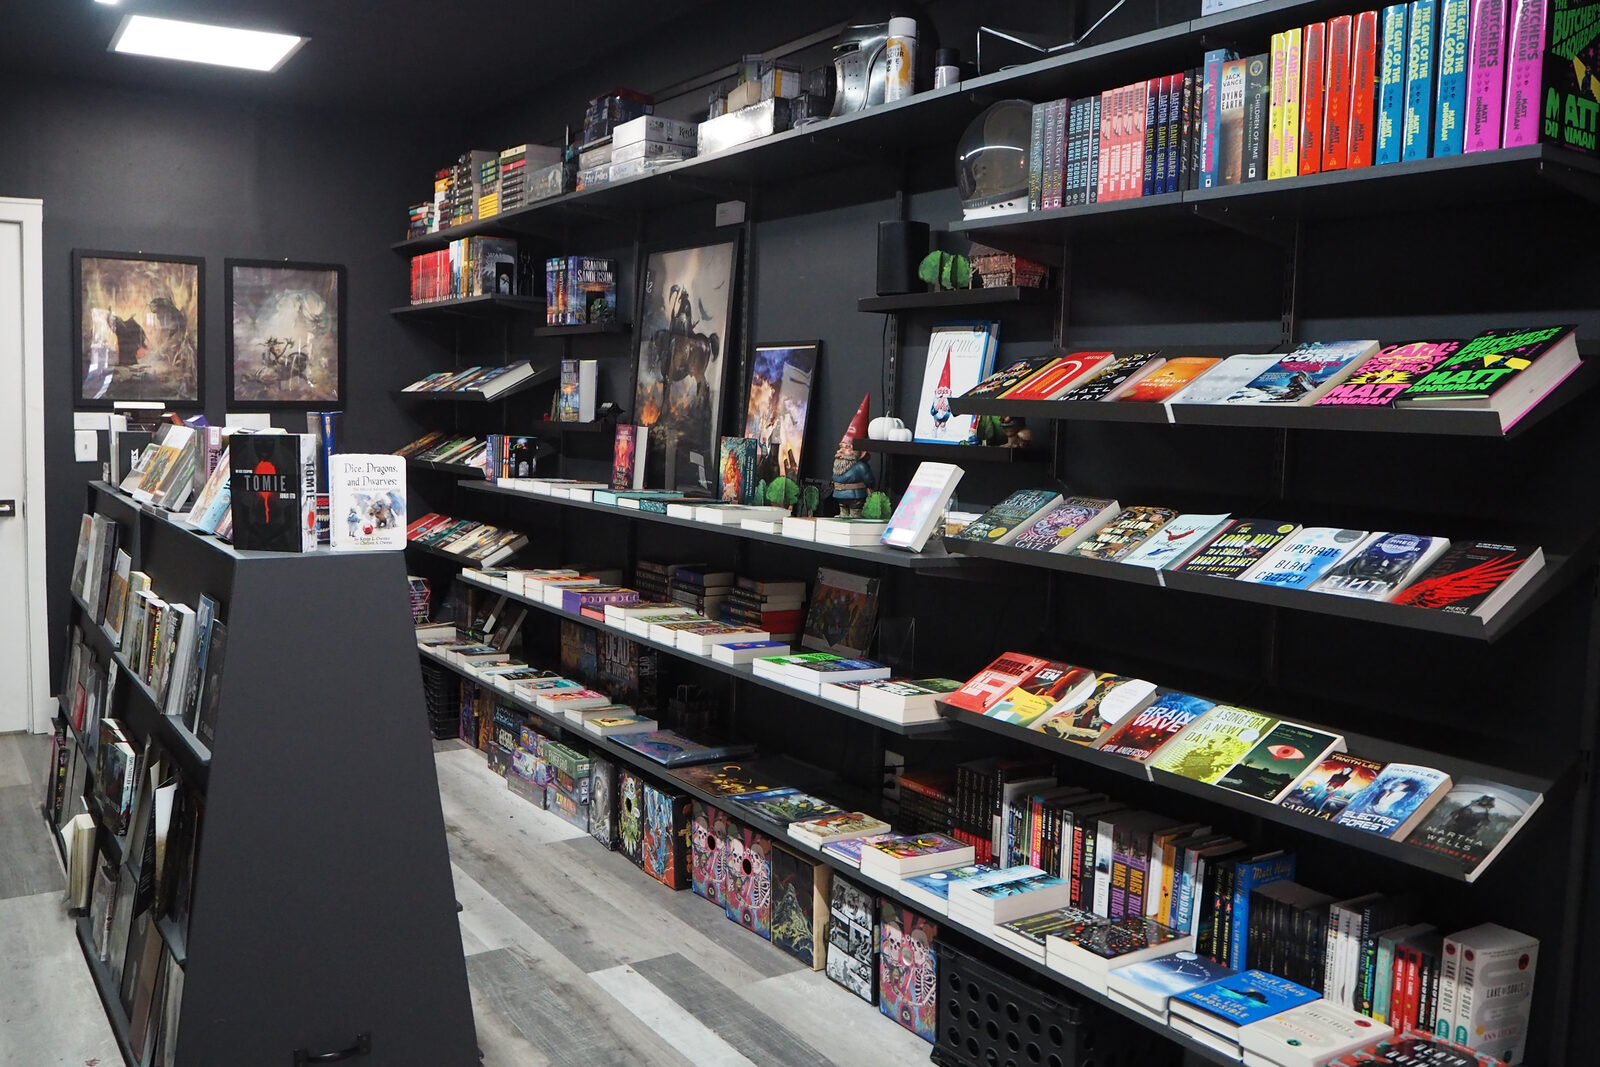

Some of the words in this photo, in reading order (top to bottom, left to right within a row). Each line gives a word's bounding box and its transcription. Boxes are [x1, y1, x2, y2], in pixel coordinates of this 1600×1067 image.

[1423, 6, 1431, 22] THE
[1458, 0, 1466, 13] THE
[1395, 12, 1403, 29] THE
[1457, 13, 1465, 40] GATE
[1395, 29, 1403, 53] GATE
[1422, 22, 1430, 48] GATE
[1420, 49, 1429, 61] OF
[1444, 38, 1455, 75] GODS
[1456, 42, 1464, 54] OF
[1383, 51, 1392, 85] GODS
[1393, 54, 1401, 66] OF
[1409, 44, 1420, 81] GODS
[1455, 55, 1463, 72] THE
[1392, 66, 1400, 83] THE
[1418, 62, 1427, 79] THE
[1223, 79, 1242, 87] VANCE
[1207, 63, 1218, 129] LEVIATHAN
[1222, 90, 1242, 101] DYING
[1147, 98, 1155, 125] DAEMON
[1159, 95, 1167, 123] DAEMON
[1170, 92, 1179, 121] DAEMON
[1222, 100, 1242, 110] EARTH
[1513, 90, 1521, 130] DINNIMAN
[1069, 106, 1077, 137] UPGRADE
[1474, 96, 1482, 135] DINNIMAN
[1169, 124, 1178, 148] DANIEL
[1253, 131, 1259, 141] OF
[1407, 108, 1415, 146] DINNIMAN
[1145, 128, 1154, 152] DANIEL
[1157, 126, 1166, 151] DANIEL
[1074, 140, 1082, 160] BLAKE
[1206, 130, 1215, 172] WAKES
[1144, 155, 1152, 180] SUAREZ
[1156, 153, 1165, 180] SUAREZ
[1168, 151, 1176, 177] SUAREZ
[1066, 164, 1074, 190] CROUCH
[583, 260, 608, 271] BRANDON
[578, 270, 613, 282] SANDERSON
[1414, 369, 1514, 386] MATT
[1322, 384, 1413, 398] MATT
[1404, 382, 1492, 393] DINNIMAN
[244, 475, 286, 492] TOMIE
[305, 460, 314, 500] TOMIE
[347, 478, 360, 486] and
[1003, 500, 1038, 509] SEASON
[1117, 520, 1154, 530] PSALM
[1015, 540, 1049, 550] GATE
[1016, 533, 1061, 545] OBELISK
[1210, 533, 1252, 548] LONG
[1251, 534, 1284, 549] WAY
[1284, 544, 1342, 558] UPGRADE
[1188, 555, 1221, 566] ANGRY
[1220, 557, 1257, 566] PLANET
[1275, 559, 1316, 572] BLAKE
[1255, 572, 1307, 584] CROUCH
[605, 632, 630, 666] DEAD
[1035, 670, 1060, 681] LEM
[1133, 714, 1182, 733] WAVE
[1140, 706, 1196, 725] BRAIN
[1216, 710, 1222, 718] A
[1221, 712, 1247, 725] SONG
[1247, 716, 1266, 729] FOR
[1184, 731, 1209, 744] DAY
[1202, 722, 1211, 730] A
[1210, 723, 1237, 735] NEW
[1101, 744, 1118, 752] POUL
[1117, 746, 1151, 758] ANDERSON
[1330, 754, 1361, 765] TANITH
[1362, 762, 1381, 771] LEE
[1389, 766, 1419, 775] TANITH
[1420, 772, 1440, 780] LEE
[1338, 817, 1390, 833] FOREST
[1342, 811, 1399, 826] ELECTRIC
[1426, 826, 1483, 846] MARTHA
[1427, 834, 1472, 852] WELLS
[1072, 829, 1083, 877] GREATEST
[1113, 862, 1126, 888] MARS
[1129, 868, 1143, 895] MARS
[1253, 867, 1273, 880] Matt
[1072, 878, 1080, 901] HITS
[1360, 940, 1368, 971] MACHINE
[1446, 961, 1456, 981] LAKE
[1464, 967, 1474, 988] LAKE
[1249, 971, 1280, 987] Matt
[1280, 981, 1306, 996] Haig
[1486, 987, 1501, 998] LAKE
[1507, 982, 1525, 996] SOULS
[1189, 992, 1249, 1019] IMPOSSIBLE
[1223, 998, 1246, 1010] LIFE
[1443, 988, 1454, 1013] SOULS
[1461, 994, 1472, 1019] SOULS
[1413, 1043, 1467, 1066] DEATH
